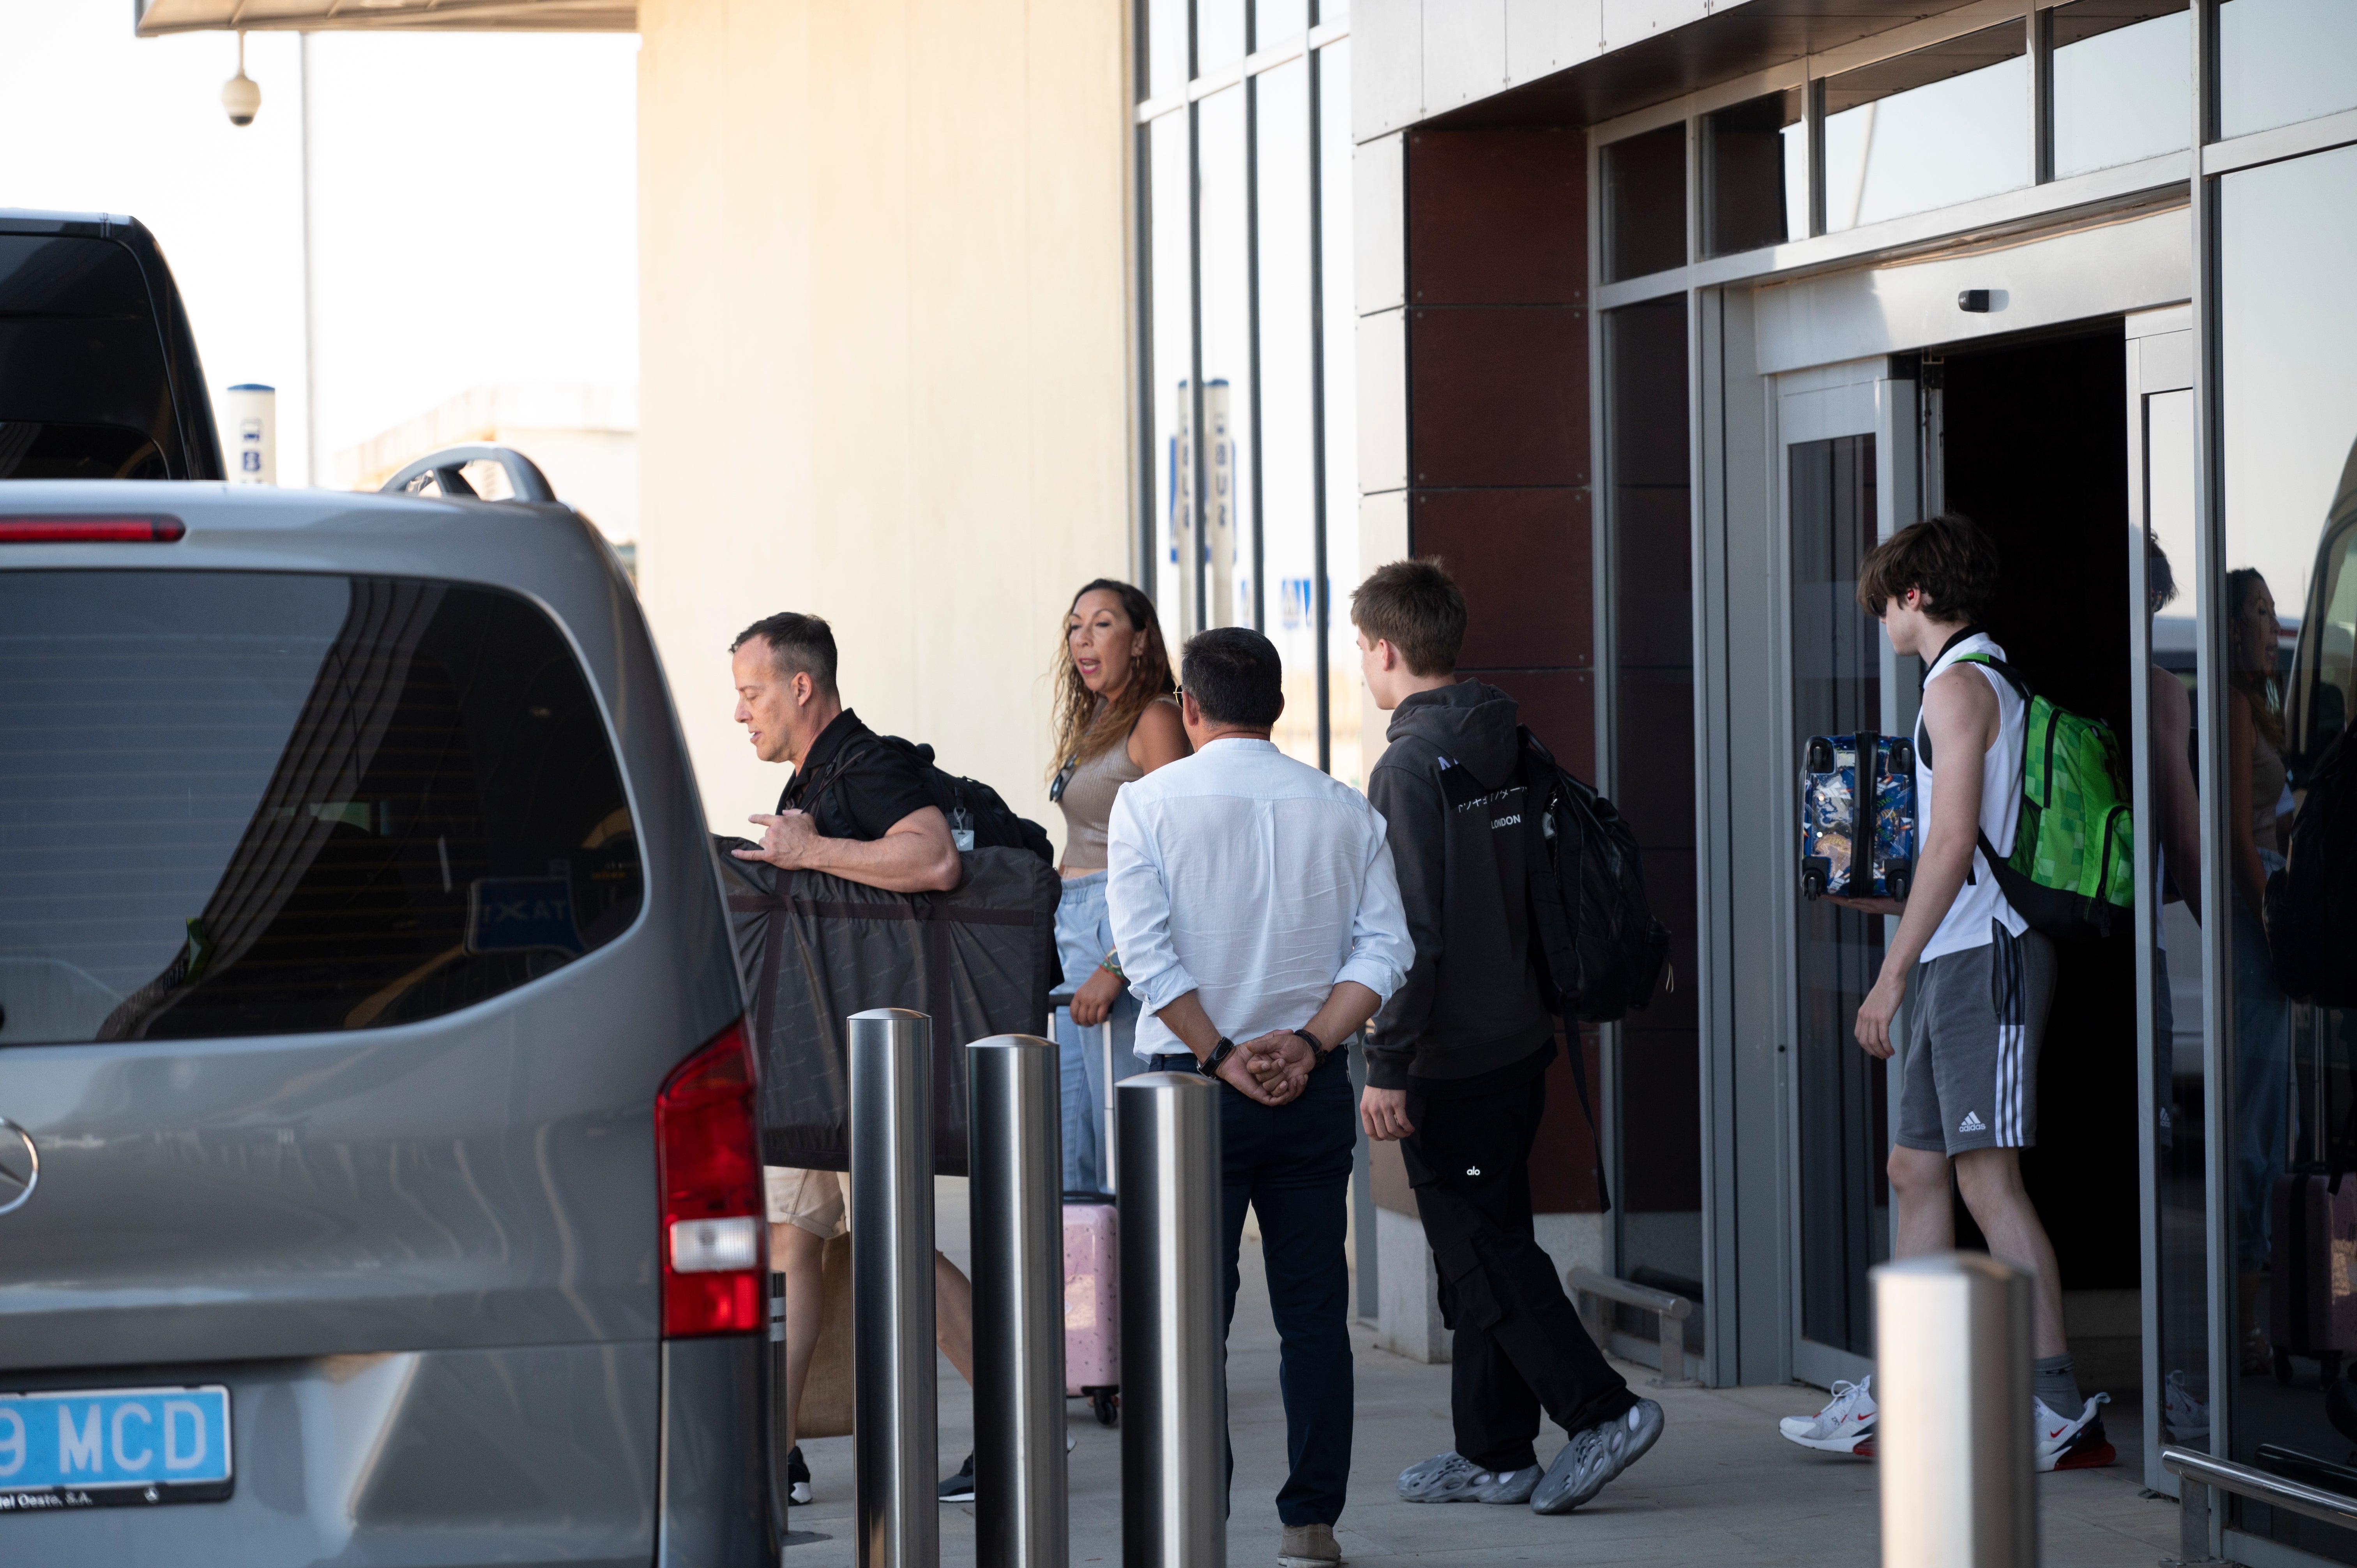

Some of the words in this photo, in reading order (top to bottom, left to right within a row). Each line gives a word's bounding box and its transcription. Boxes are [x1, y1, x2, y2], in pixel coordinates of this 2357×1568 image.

[1491, 814, 1521, 829] LONDON
[1959, 1123, 1986, 1133] adidas
[1466, 1165, 1481, 1176] alo
[58, 1400, 207, 1474] MCD
[65, 1490, 93, 1506] S.A.
